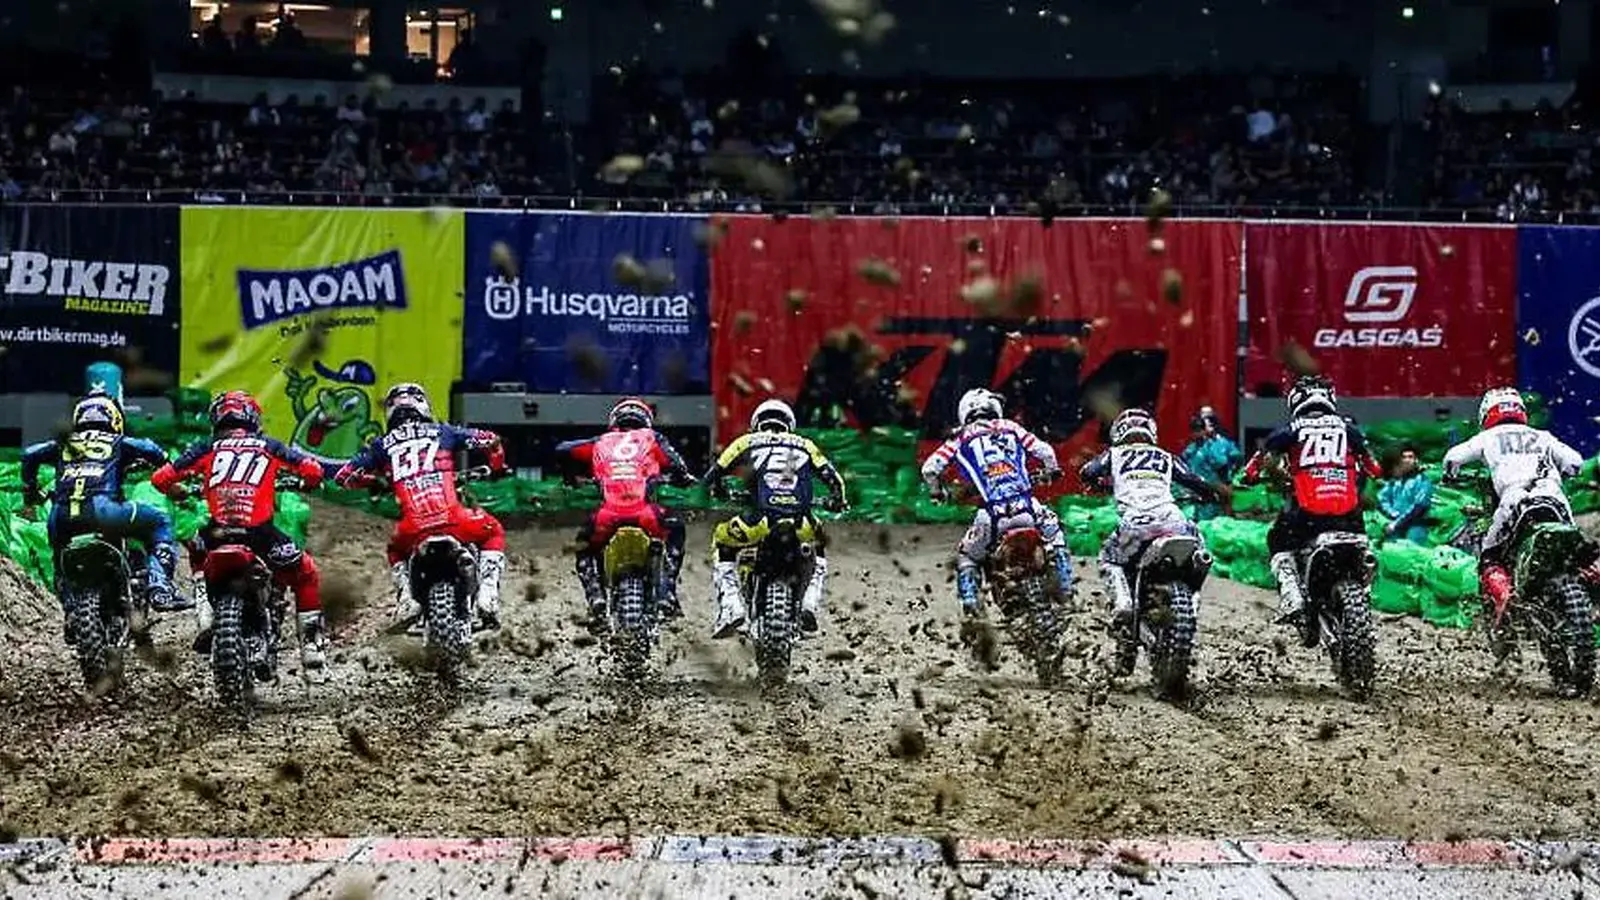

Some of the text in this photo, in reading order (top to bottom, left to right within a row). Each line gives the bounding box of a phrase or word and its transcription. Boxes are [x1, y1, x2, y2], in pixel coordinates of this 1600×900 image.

[65, 297, 149, 315] MAGAZINE
[250, 263, 396, 319] MAOAM
[526, 286, 689, 320] Husqvarna
[1314, 328, 1443, 347] GASGAS
[1119, 450, 1169, 474] 225
[1298, 428, 1348, 467] 260
[209, 450, 269, 488] 911
